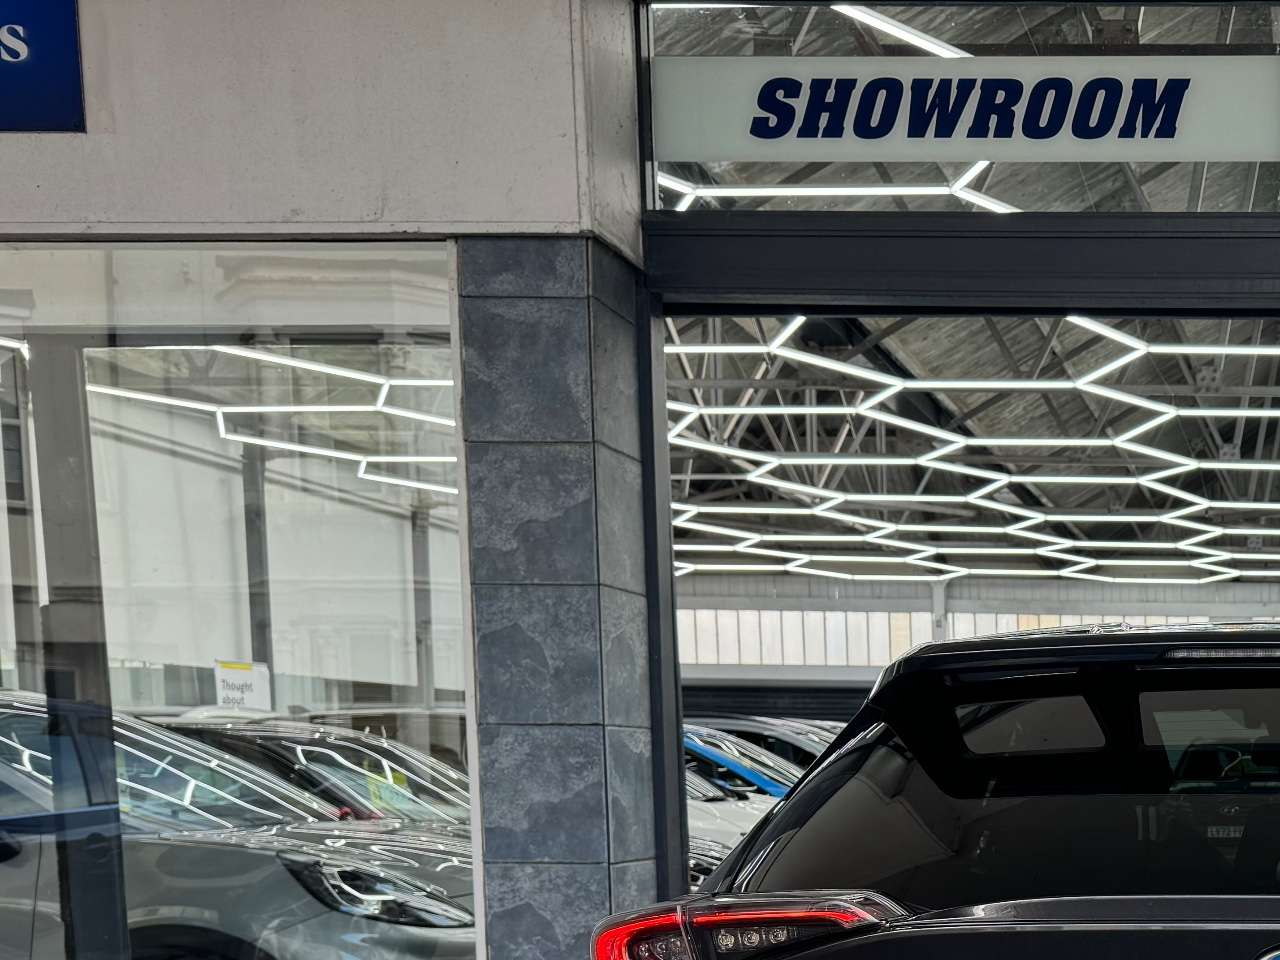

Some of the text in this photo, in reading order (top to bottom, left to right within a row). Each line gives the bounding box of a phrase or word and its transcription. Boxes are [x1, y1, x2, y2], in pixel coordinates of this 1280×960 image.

[749, 77, 1191, 139] SHOWROOM
[221, 679, 253, 694] Thought
[222, 695, 245, 704] about
